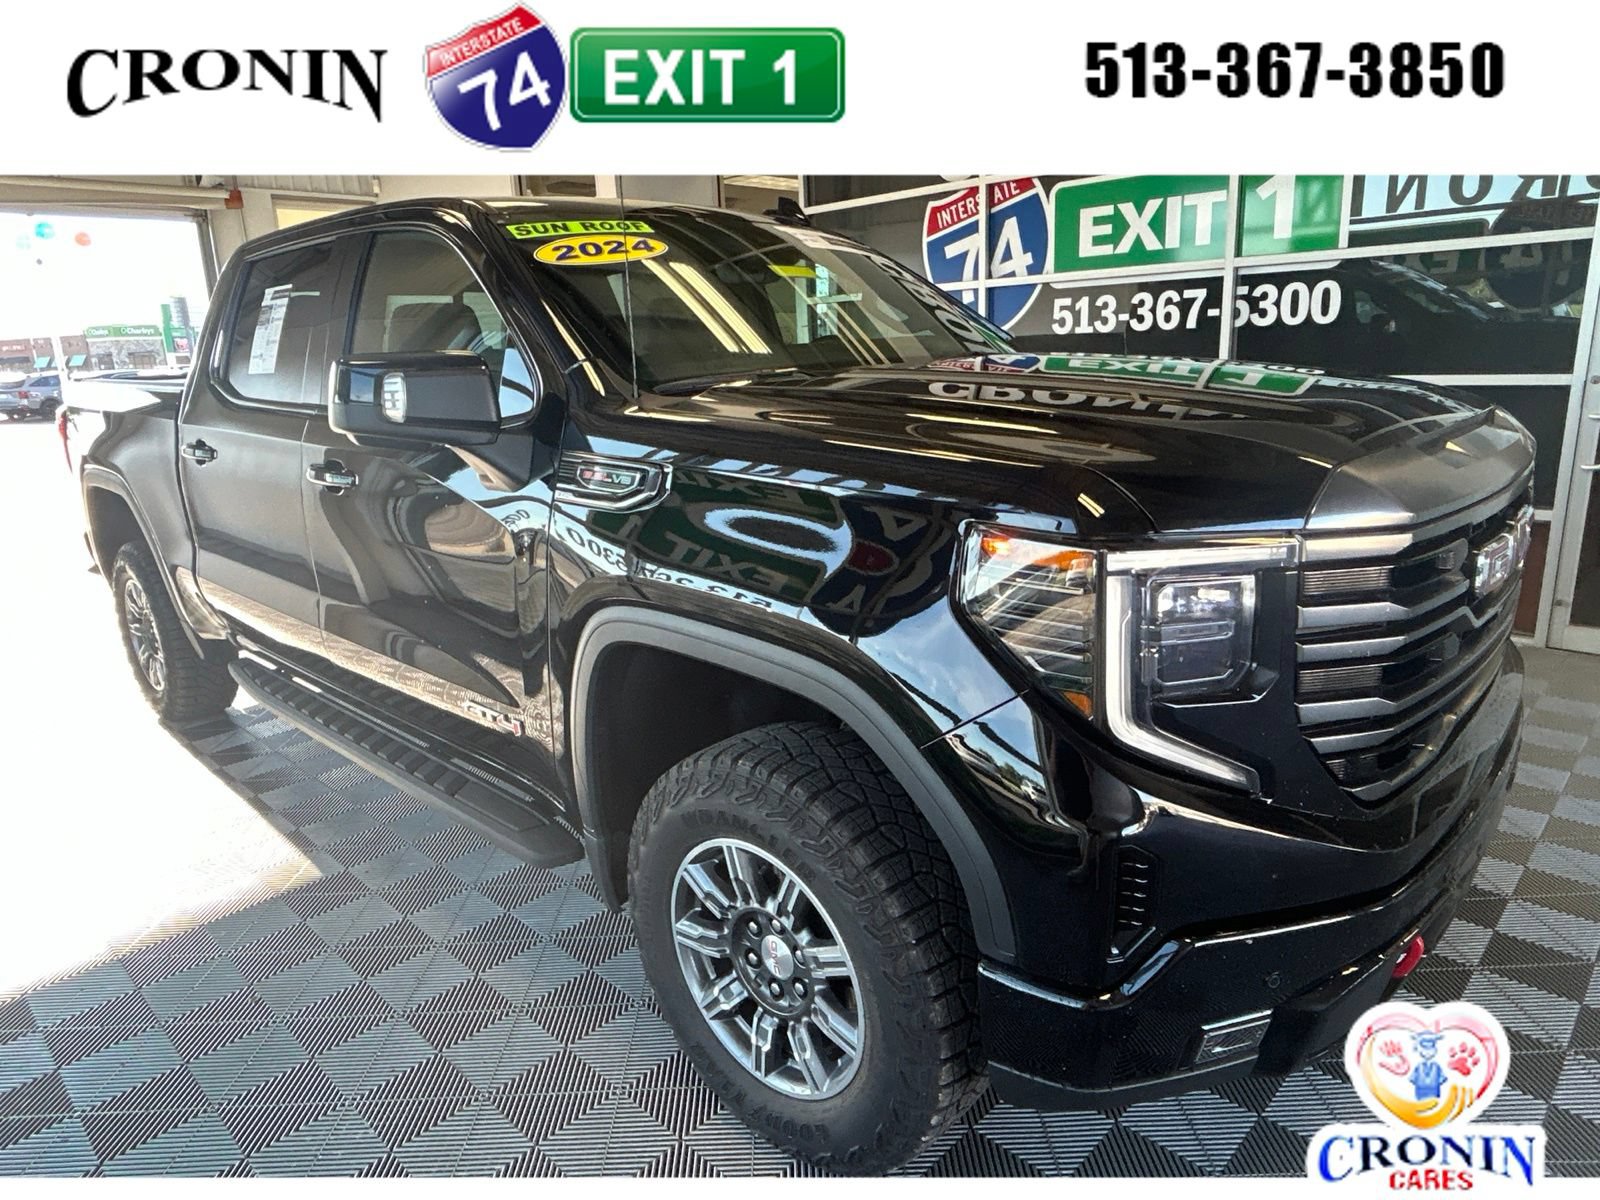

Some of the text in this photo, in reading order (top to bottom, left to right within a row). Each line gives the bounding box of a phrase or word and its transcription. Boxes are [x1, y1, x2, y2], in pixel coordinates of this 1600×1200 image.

[514, 221, 647, 237] SUN ROOF
[1078, 175, 1295, 258] EXIT 1
[551, 239, 658, 261] 2024
[944, 216, 1034, 304] 74
[1051, 280, 1342, 335] 513-367-5300
